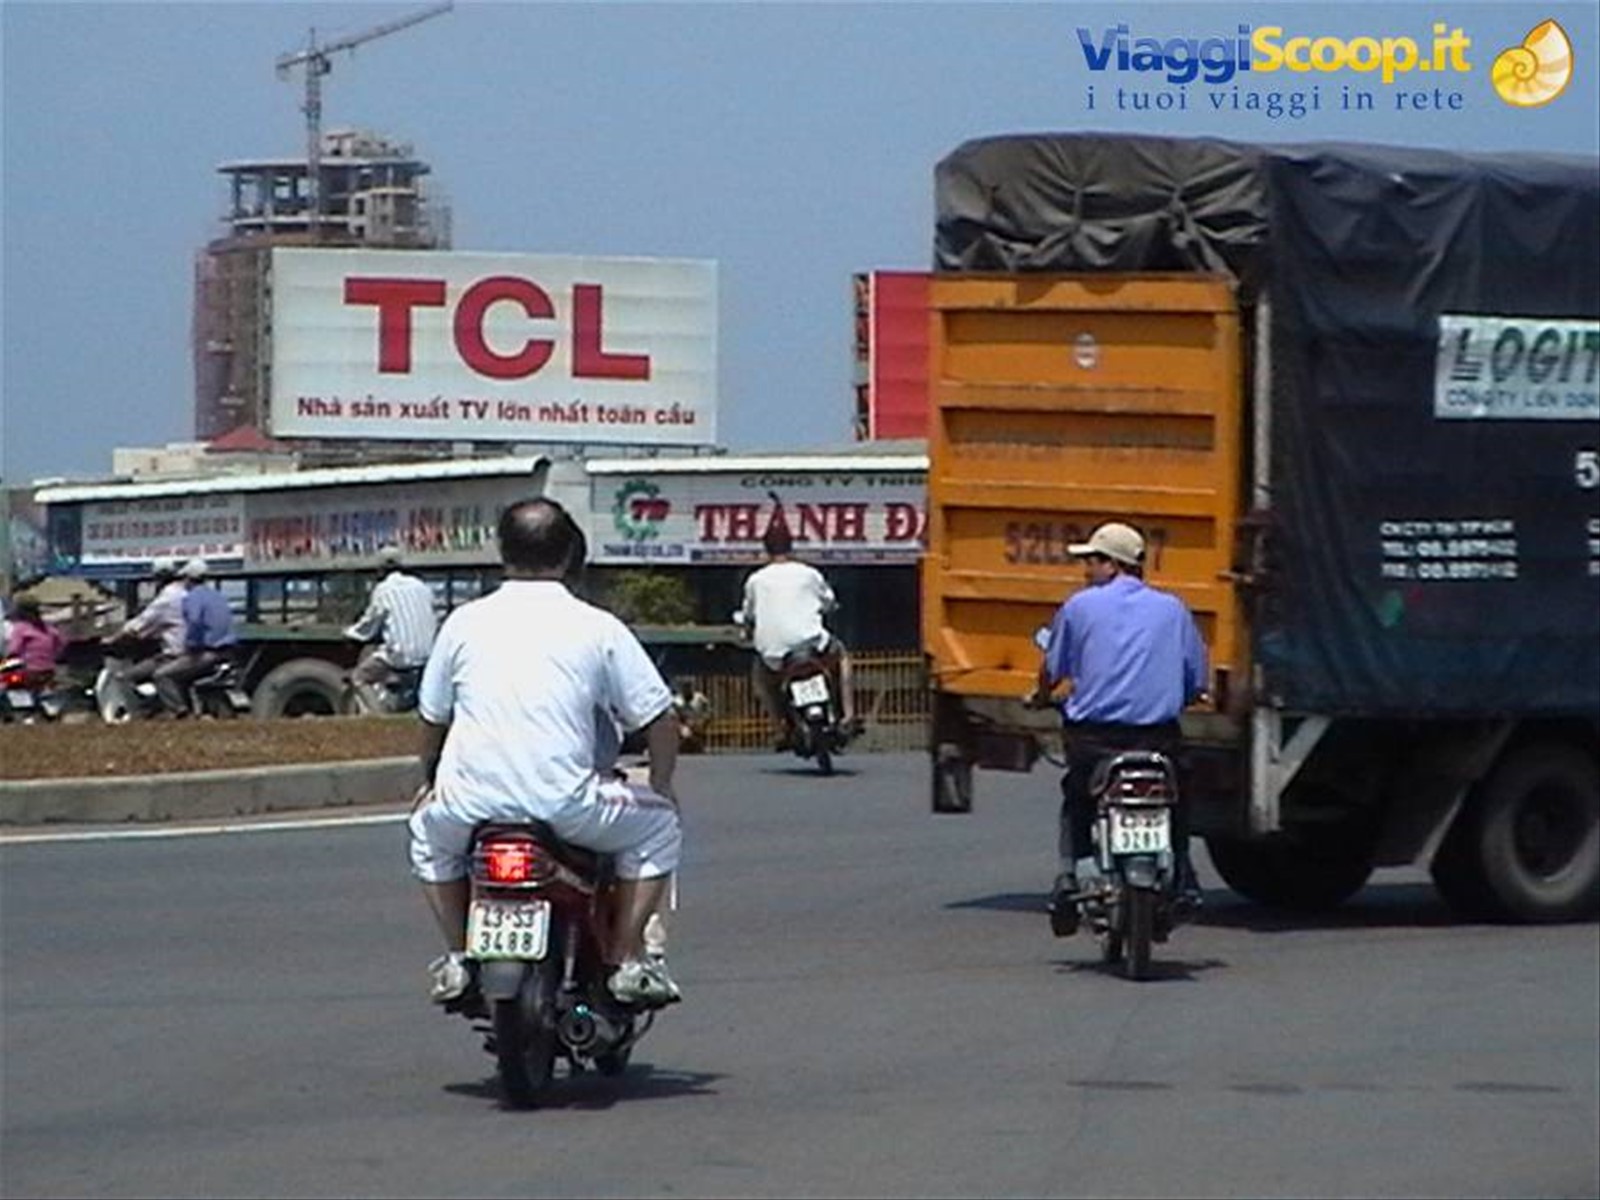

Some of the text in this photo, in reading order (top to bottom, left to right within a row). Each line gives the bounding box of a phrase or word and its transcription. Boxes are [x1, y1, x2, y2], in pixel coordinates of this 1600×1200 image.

[343, 275, 651, 381] TCL
[297, 396, 342, 418] Nhà
[350, 394, 391, 418] sản
[400, 395, 449, 419] xuất
[459, 400, 489, 419] TV
[538, 399, 588, 423] nhất
